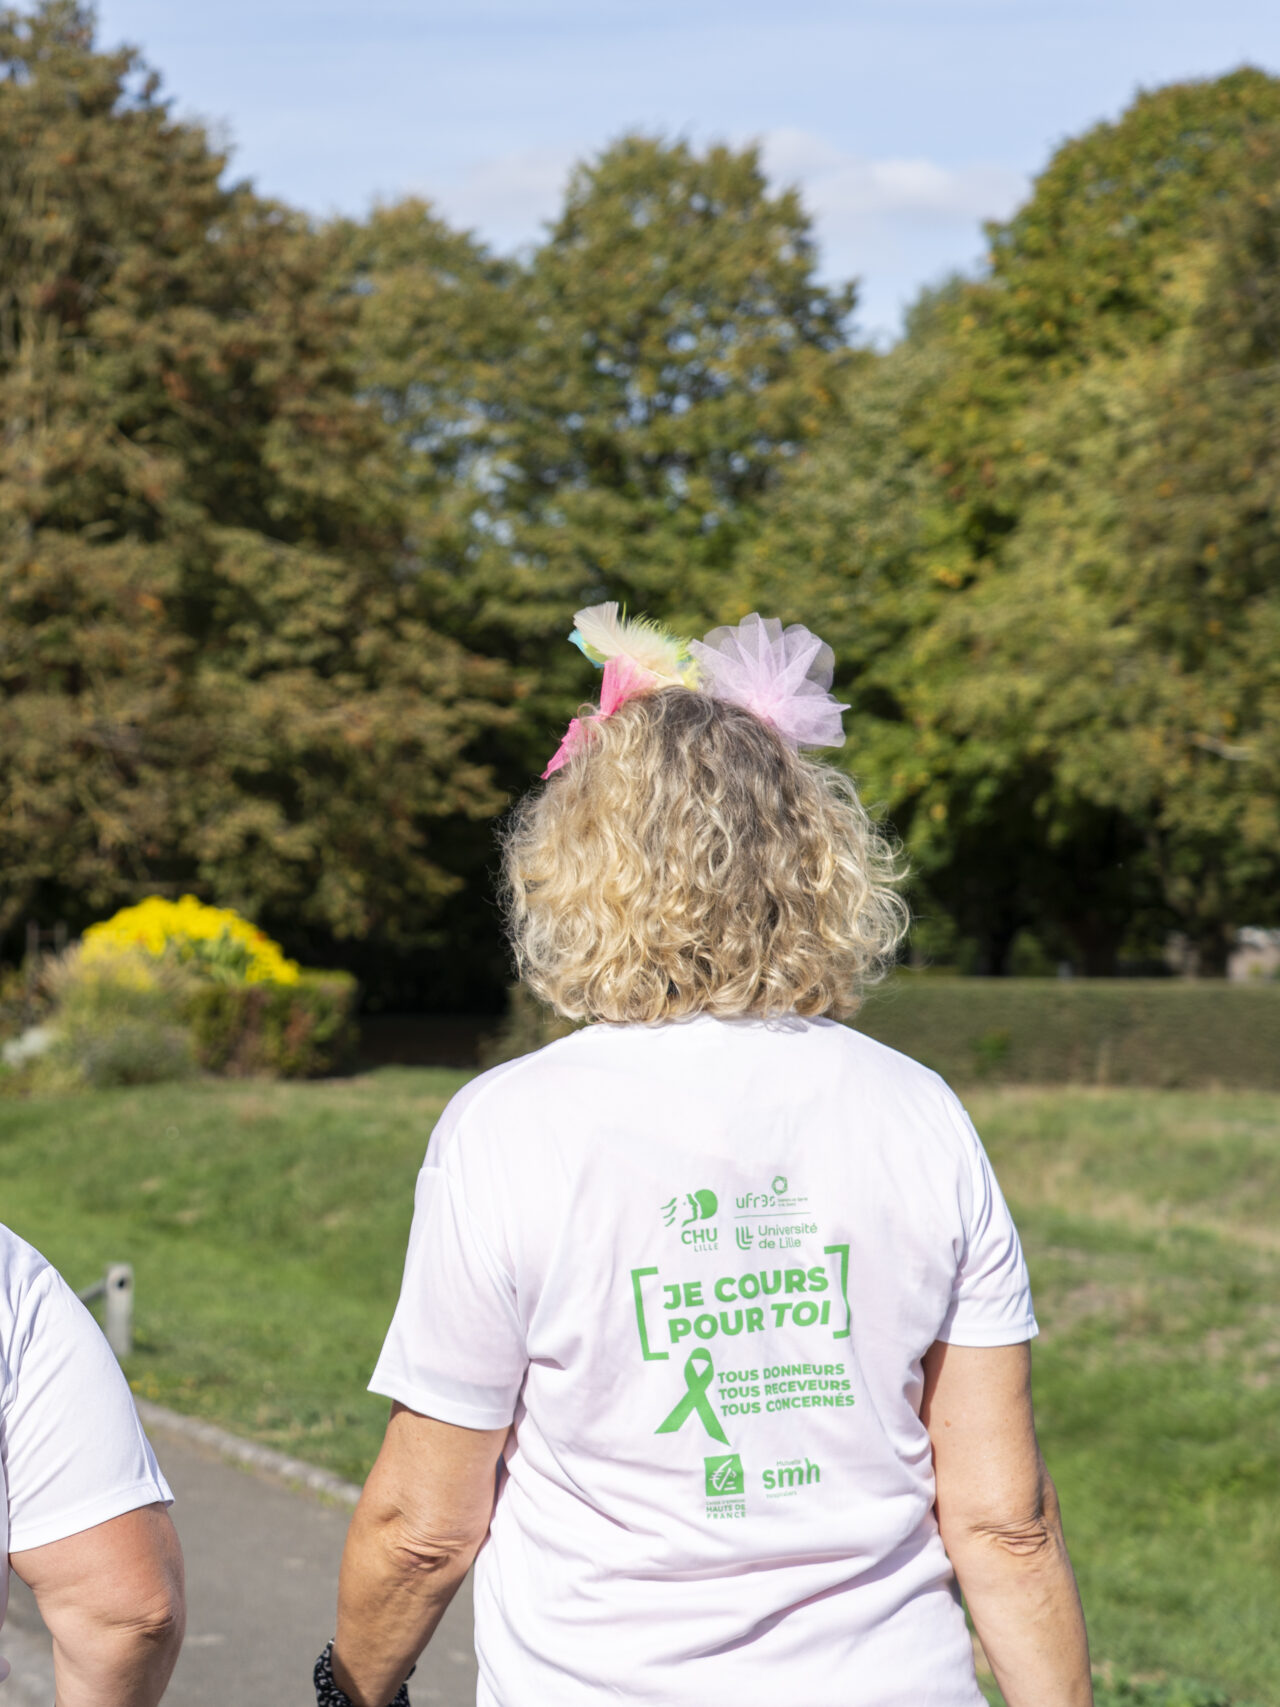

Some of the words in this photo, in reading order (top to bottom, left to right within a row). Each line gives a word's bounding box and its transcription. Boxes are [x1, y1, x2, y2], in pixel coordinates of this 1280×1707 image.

[681, 1227, 718, 1245] CHU
[758, 1222, 818, 1237] Université
[694, 1242, 719, 1253] LILLE
[758, 1237, 776, 1249] de
[779, 1237, 802, 1249] Lille
[663, 1281, 705, 1310] JE
[714, 1266, 829, 1303] COURS
[668, 1306, 766, 1344] POUR
[770, 1299, 831, 1329] TOI
[717, 1369, 760, 1384] TOUS
[763, 1363, 845, 1380] DONNEURS
[718, 1385, 761, 1400] TOUS
[765, 1379, 851, 1396] RECEVEURS
[720, 1402, 761, 1417] TOUS
[766, 1393, 855, 1412] CONCERNÉS
[762, 1457, 821, 1490] smh
